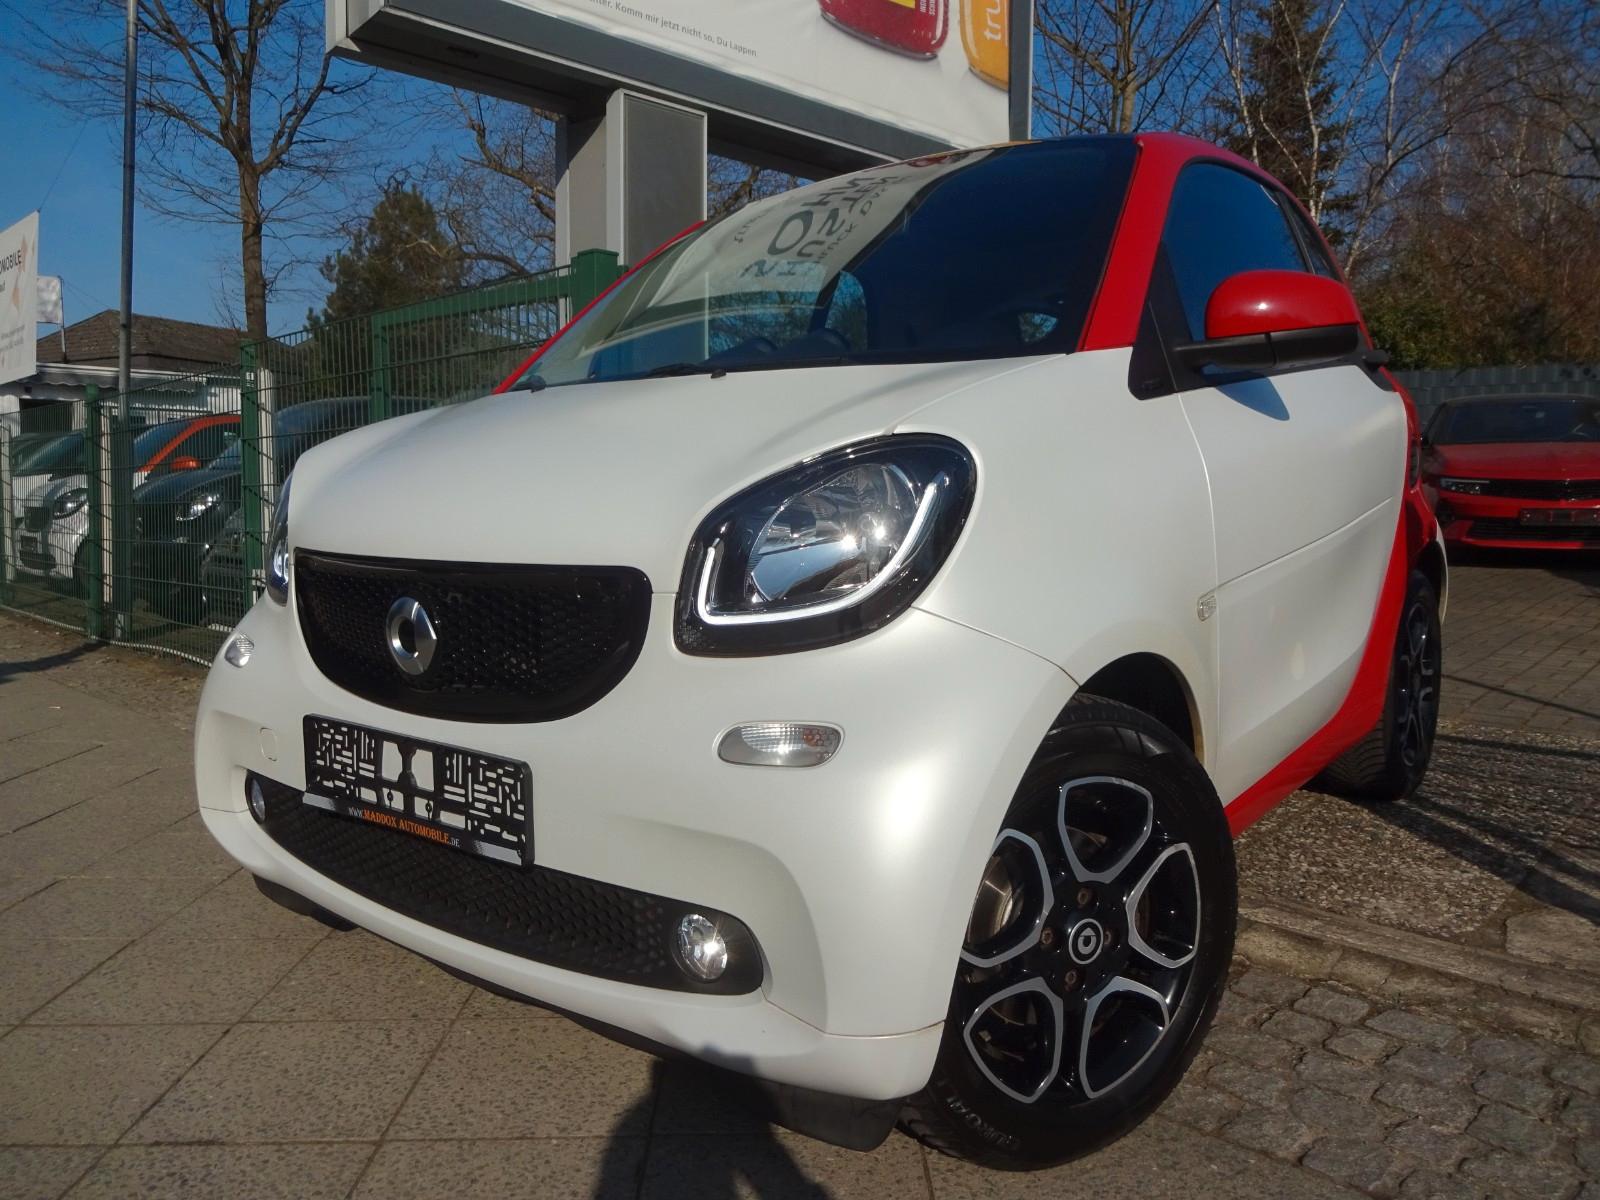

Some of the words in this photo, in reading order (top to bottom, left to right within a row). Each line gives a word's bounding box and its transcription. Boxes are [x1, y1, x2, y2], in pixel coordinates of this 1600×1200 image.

[615, 0, 643, 18] Komm
[645, 11, 659, 24] mir
[660, 16, 680, 31] jetzt
[681, 25, 702, 38] nicht
[716, 35, 728, 47] Du
[729, 41, 758, 57] Lappen
